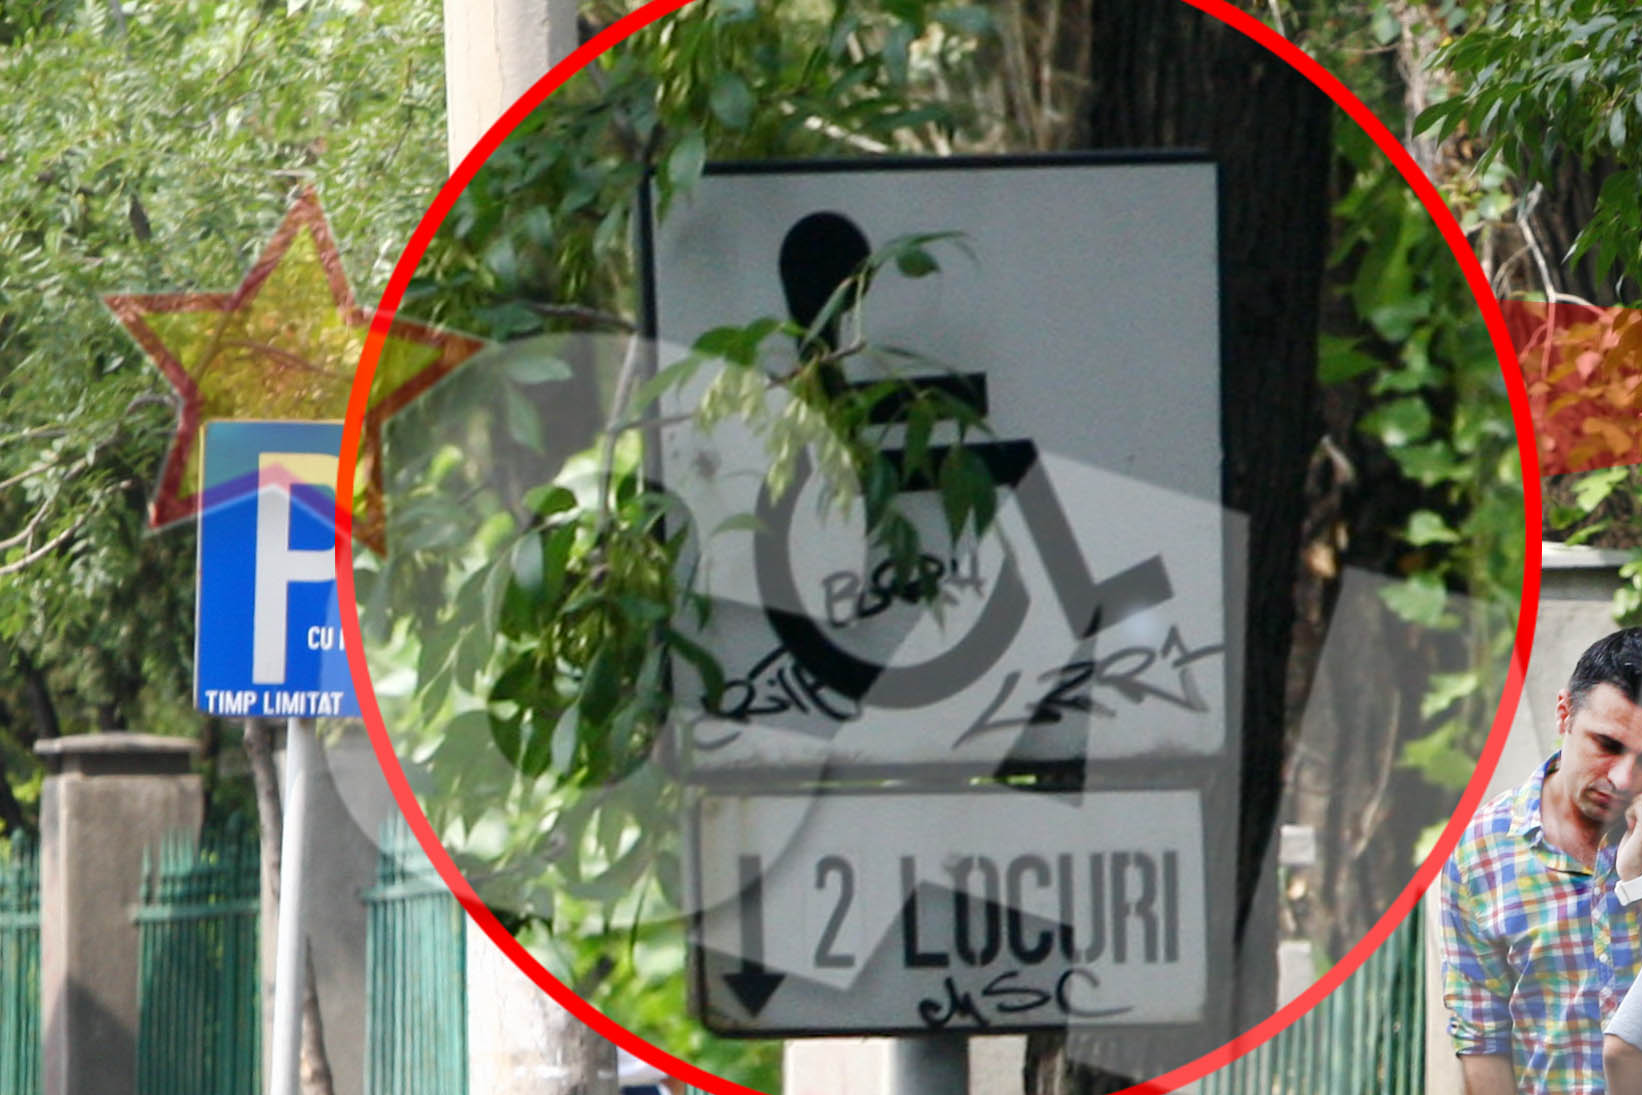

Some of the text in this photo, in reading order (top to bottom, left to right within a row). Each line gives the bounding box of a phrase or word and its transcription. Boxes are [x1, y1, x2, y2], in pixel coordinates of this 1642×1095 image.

[307, 626, 334, 650] CU
[205, 690, 344, 716] TIMP LIMITAT
[814, 850, 1180, 969] 2 LOCURI
